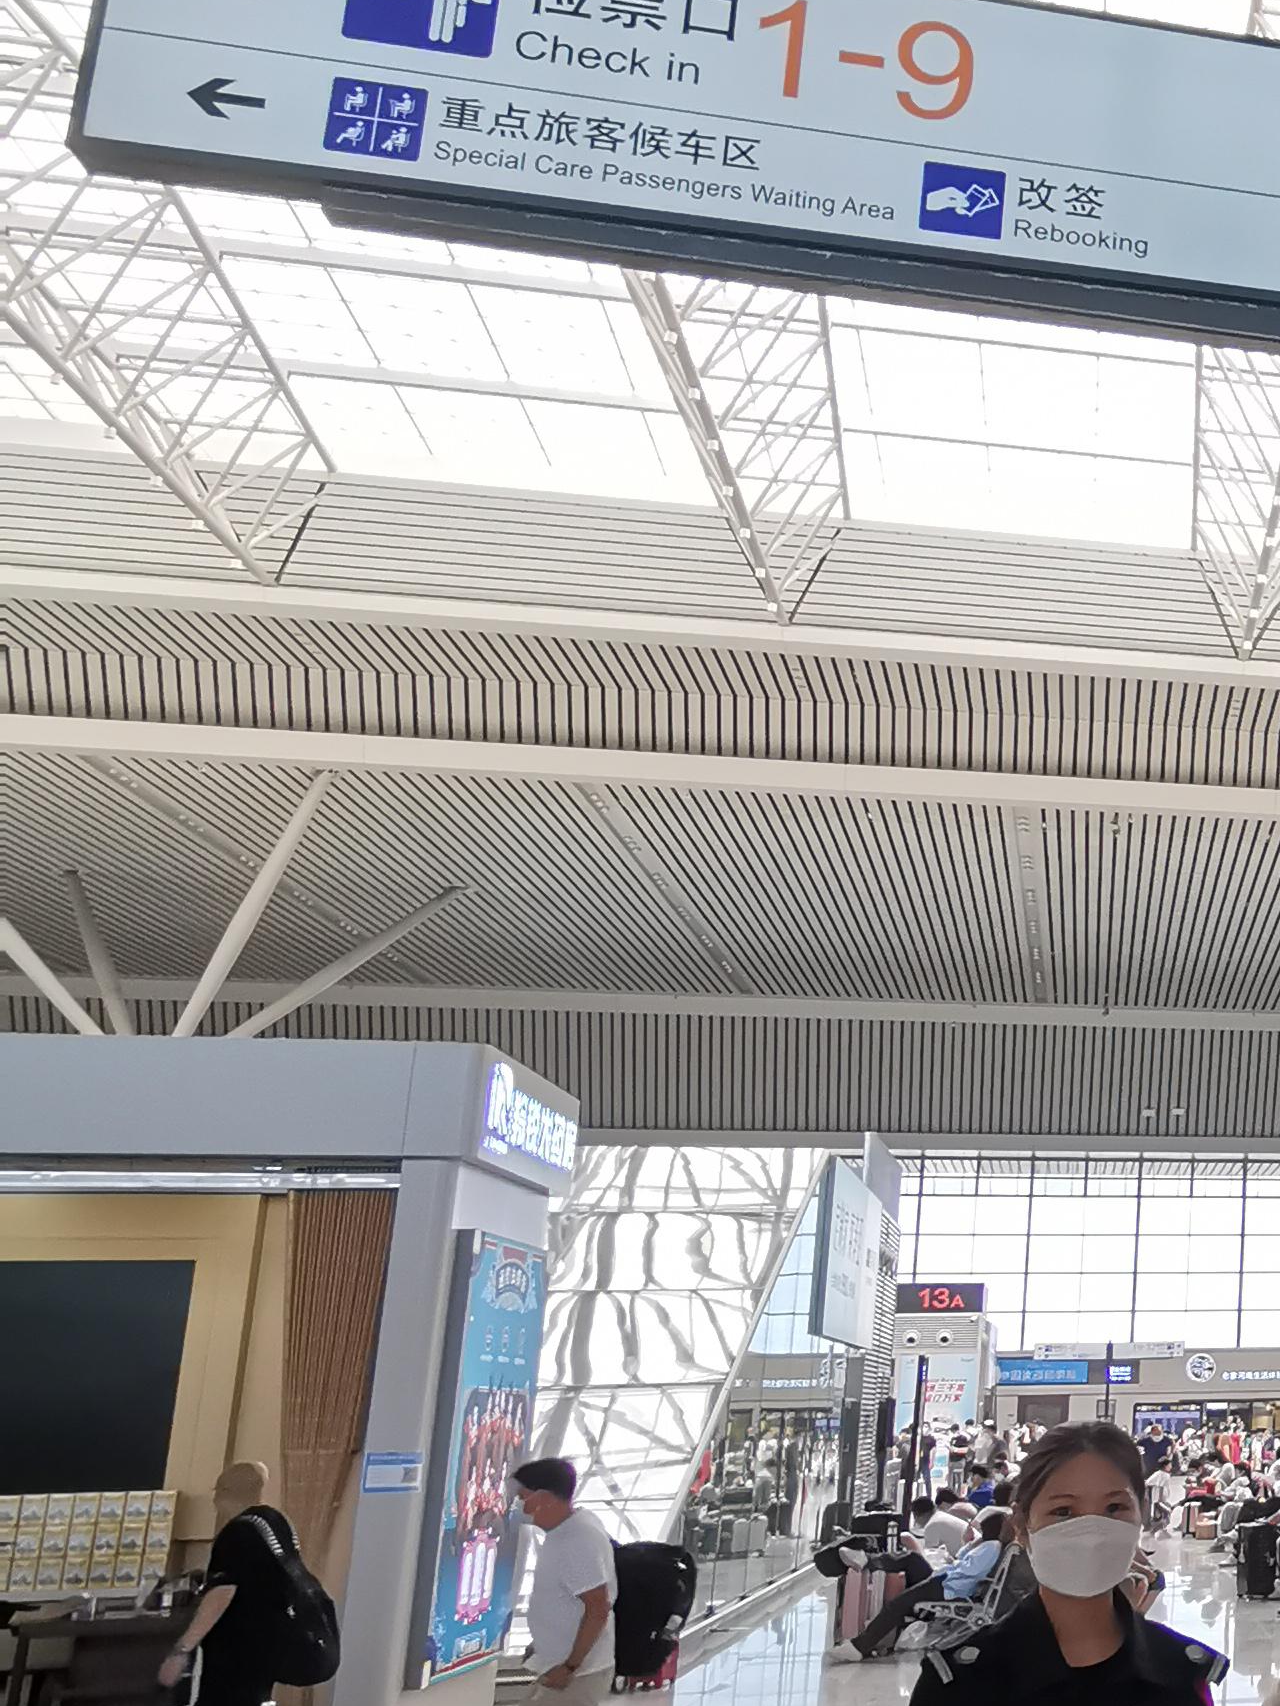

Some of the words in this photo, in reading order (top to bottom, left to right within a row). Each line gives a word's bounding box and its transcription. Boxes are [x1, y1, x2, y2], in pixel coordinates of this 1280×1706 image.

[516, 31, 648, 77] Check
[666, 50, 700, 84] in
[758, 0, 974, 120] 1-9
[440, 97, 761, 171] 重点旅客候车区
[434, 140, 525, 175] Special
[535, 154, 593, 181] Care
[602, 161, 742, 203] Passengers
[751, 183, 835, 217] Waiting
[842, 194, 895, 222] Area
[1016, 177, 1107, 220] 改签
[1013, 219, 1148, 258] Rebooking
[918, 1287, 965, 1309] 13A
